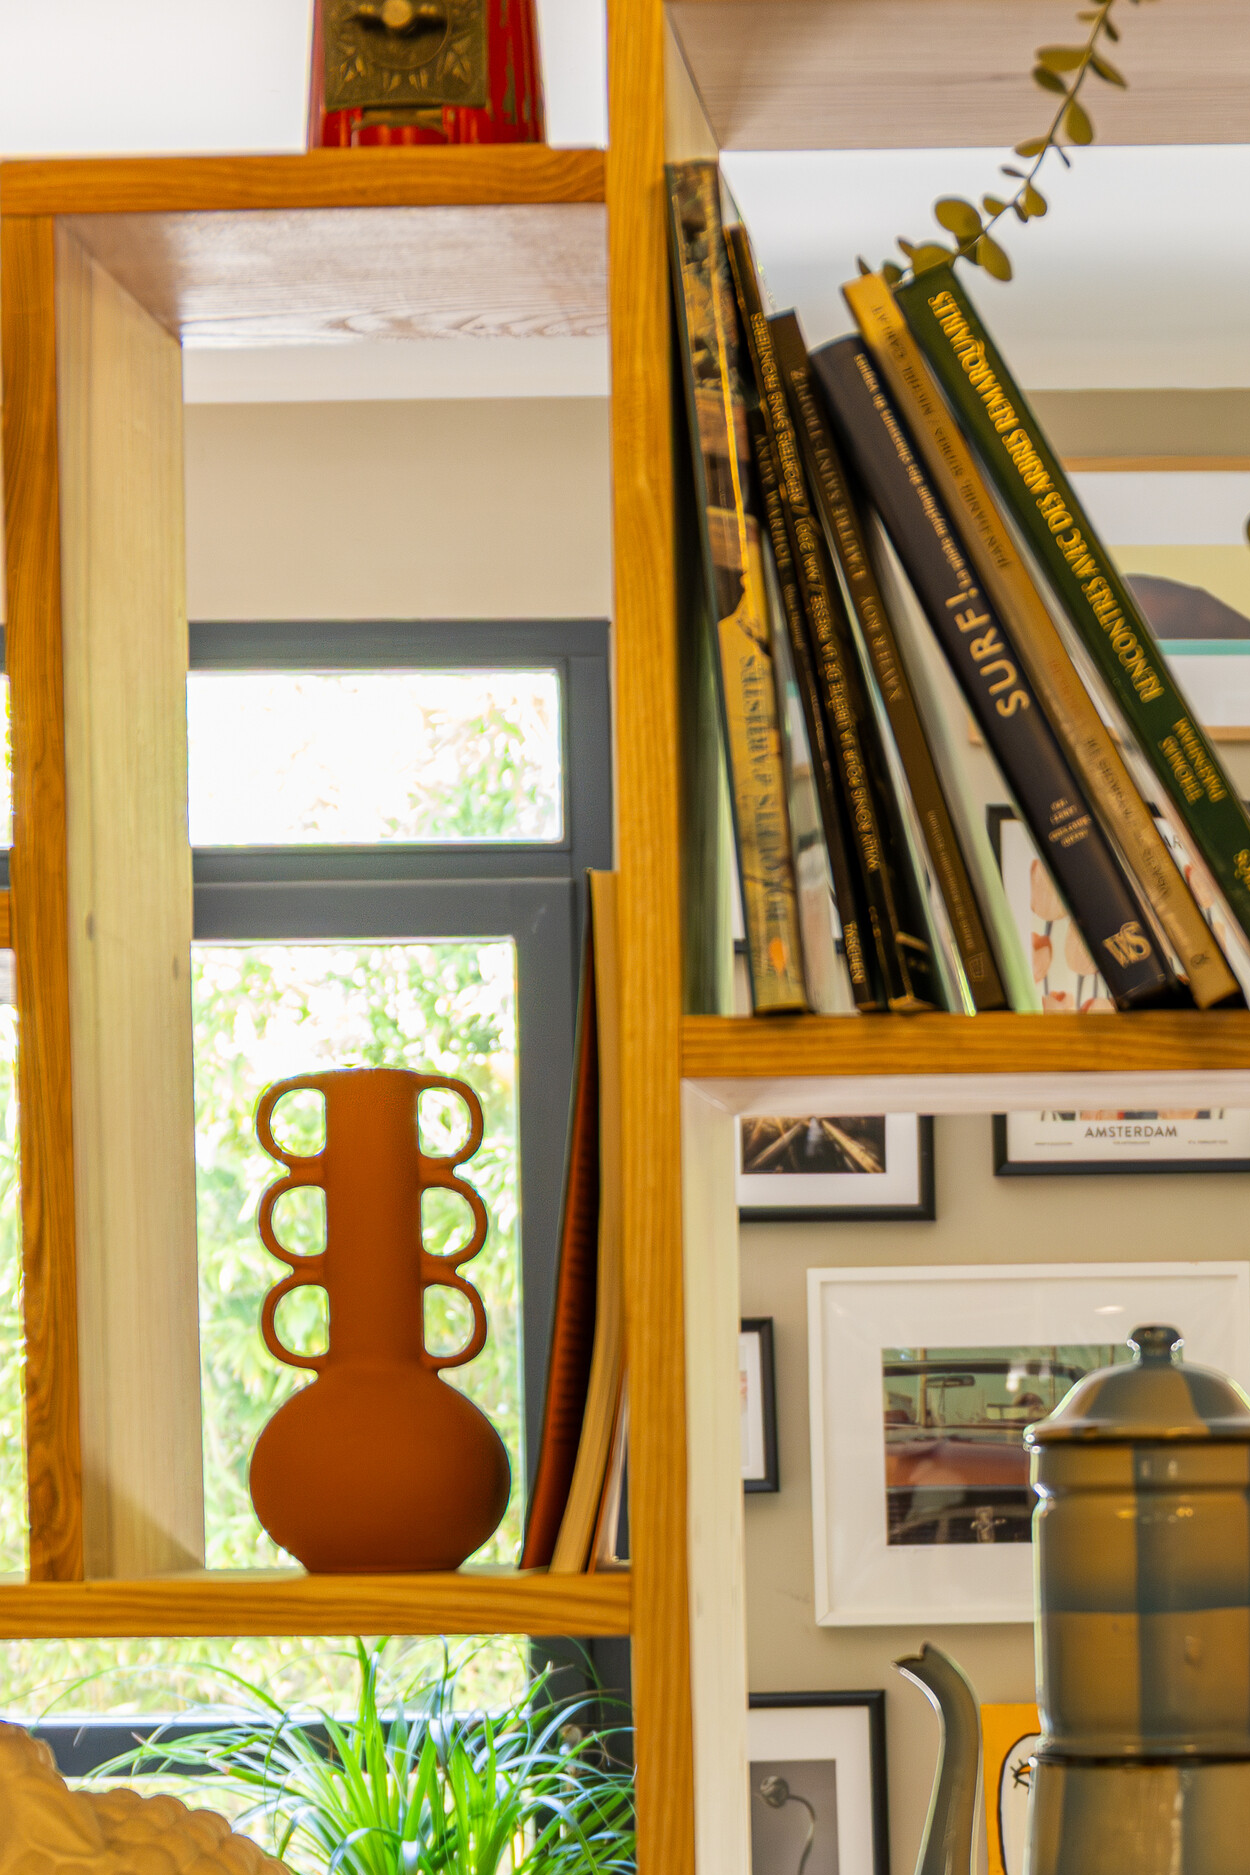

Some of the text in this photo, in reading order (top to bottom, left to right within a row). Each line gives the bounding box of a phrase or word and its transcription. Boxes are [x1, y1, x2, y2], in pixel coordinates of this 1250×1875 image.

[766, 390, 790, 430] SANS
[774, 430, 805, 503] REPORTERS
[924, 285, 1167, 705] RENCONTRES AVEC DES ARBRES REMARQUABLES
[799, 552, 821, 582] MAI
[806, 592, 832, 641] PRESSE
[815, 639, 836, 660] LA
[819, 659, 841, 682] DE
[834, 726, 856, 748] LA
[839, 747, 865, 788] POUR
[1155, 733, 1207, 805] THOMAS
[1168, 715, 1230, 804] PAKENHAM
[848, 786, 876, 834] RONIS
[858, 831, 884, 872] WILLY
[840, 920, 868, 985] TASCHEN
[1084, 1125, 1178, 1138] AMSTERDAM
